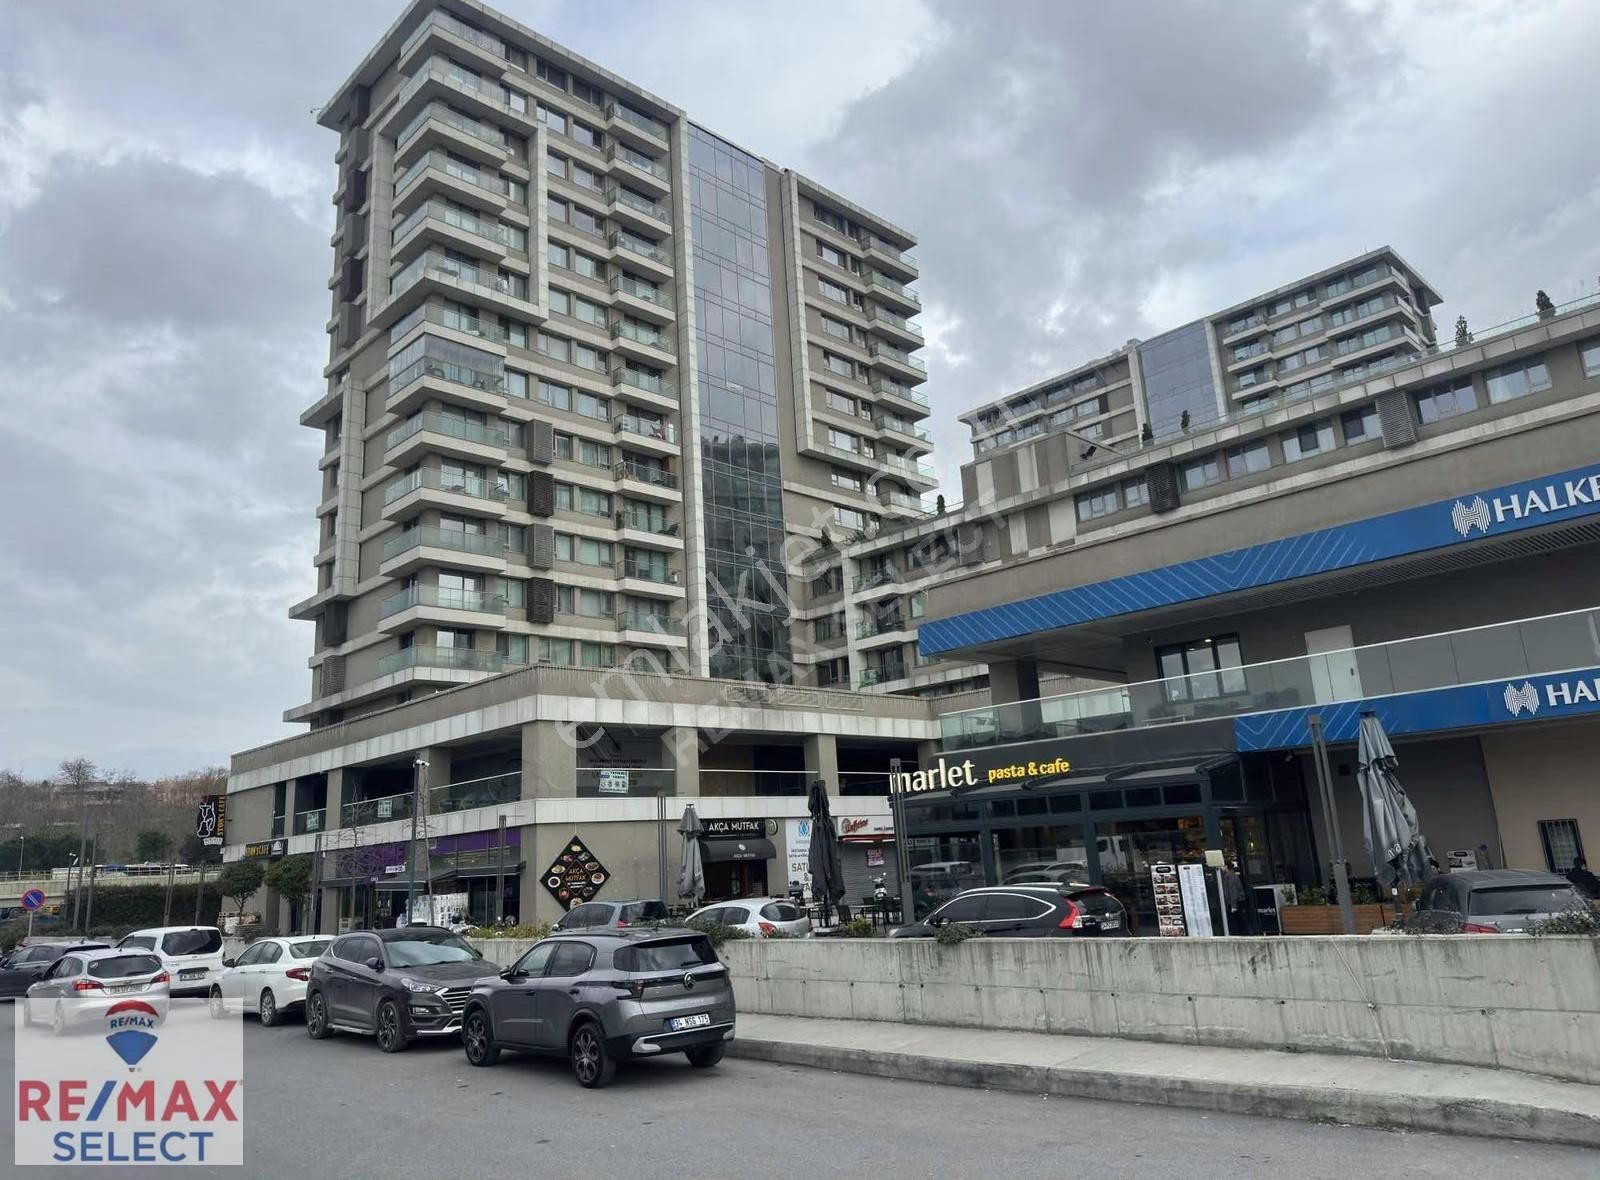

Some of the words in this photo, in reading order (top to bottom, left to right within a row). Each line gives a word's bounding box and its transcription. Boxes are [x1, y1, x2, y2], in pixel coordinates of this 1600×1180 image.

[988, 765, 1025, 783] pasta
[1039, 758, 1070, 775] cafe
[708, 822, 730, 833] AKÇA
[731, 821, 760, 831] MUTFAK
[569, 867, 584, 875] AKÇA
